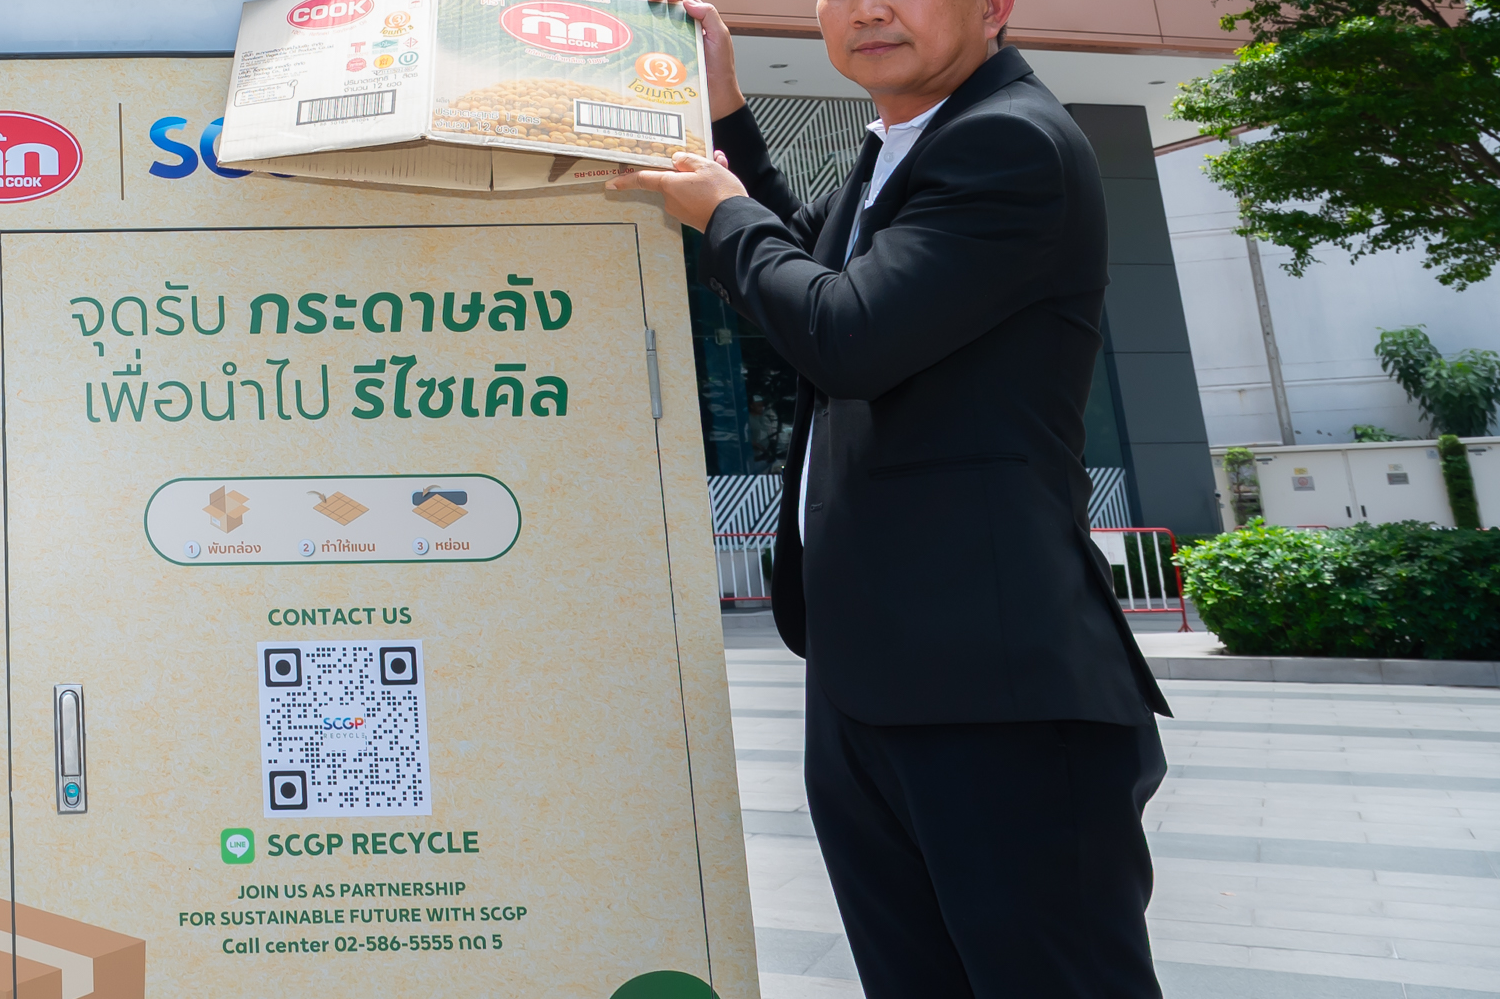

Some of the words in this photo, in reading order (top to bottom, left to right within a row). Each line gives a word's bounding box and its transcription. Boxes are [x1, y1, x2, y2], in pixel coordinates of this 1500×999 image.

[293, 0, 368, 23] COOK
[568, 38, 599, 50] COOK
[684, 86, 698, 98] 3
[476, 121, 491, 132] 12
[5, 176, 42, 188] COOK
[70, 280, 226, 356] จุดรับ
[249, 274, 572, 334] กระดาษลัง
[86, 348, 329, 422] เพื่อนำไป
[351, 354, 568, 419] รีไซเคิล
[207, 539, 262, 555] พับกล่อง
[321, 539, 376, 554] ทำให้แบน
[434, 538, 470, 552] หย่อน
[268, 608, 376, 626] CONTACT
[382, 607, 412, 624] US
[323, 717, 364, 730] SCGP
[229, 840, 246, 849] LINE
[267, 833, 344, 856] SCGP
[351, 831, 480, 855] RECYCLE
[237, 885, 280, 900] JOIN
[284, 884, 308, 898] US
[312, 883, 336, 898] AS
[340, 882, 466, 898] PARTNERSHIP
[179, 911, 216, 926] FOR
[220, 909, 345, 926] SUSTAINABLE
[350, 908, 422, 924] FUTURE
[426, 907, 475, 922] WITH
[480, 906, 528, 921] SCGP
[222, 937, 260, 954] Call
[265, 937, 329, 953] center
[334, 934, 454, 952] 02-586-5555
[458, 935, 487, 950] กด
[492, 934, 504, 950] 5
